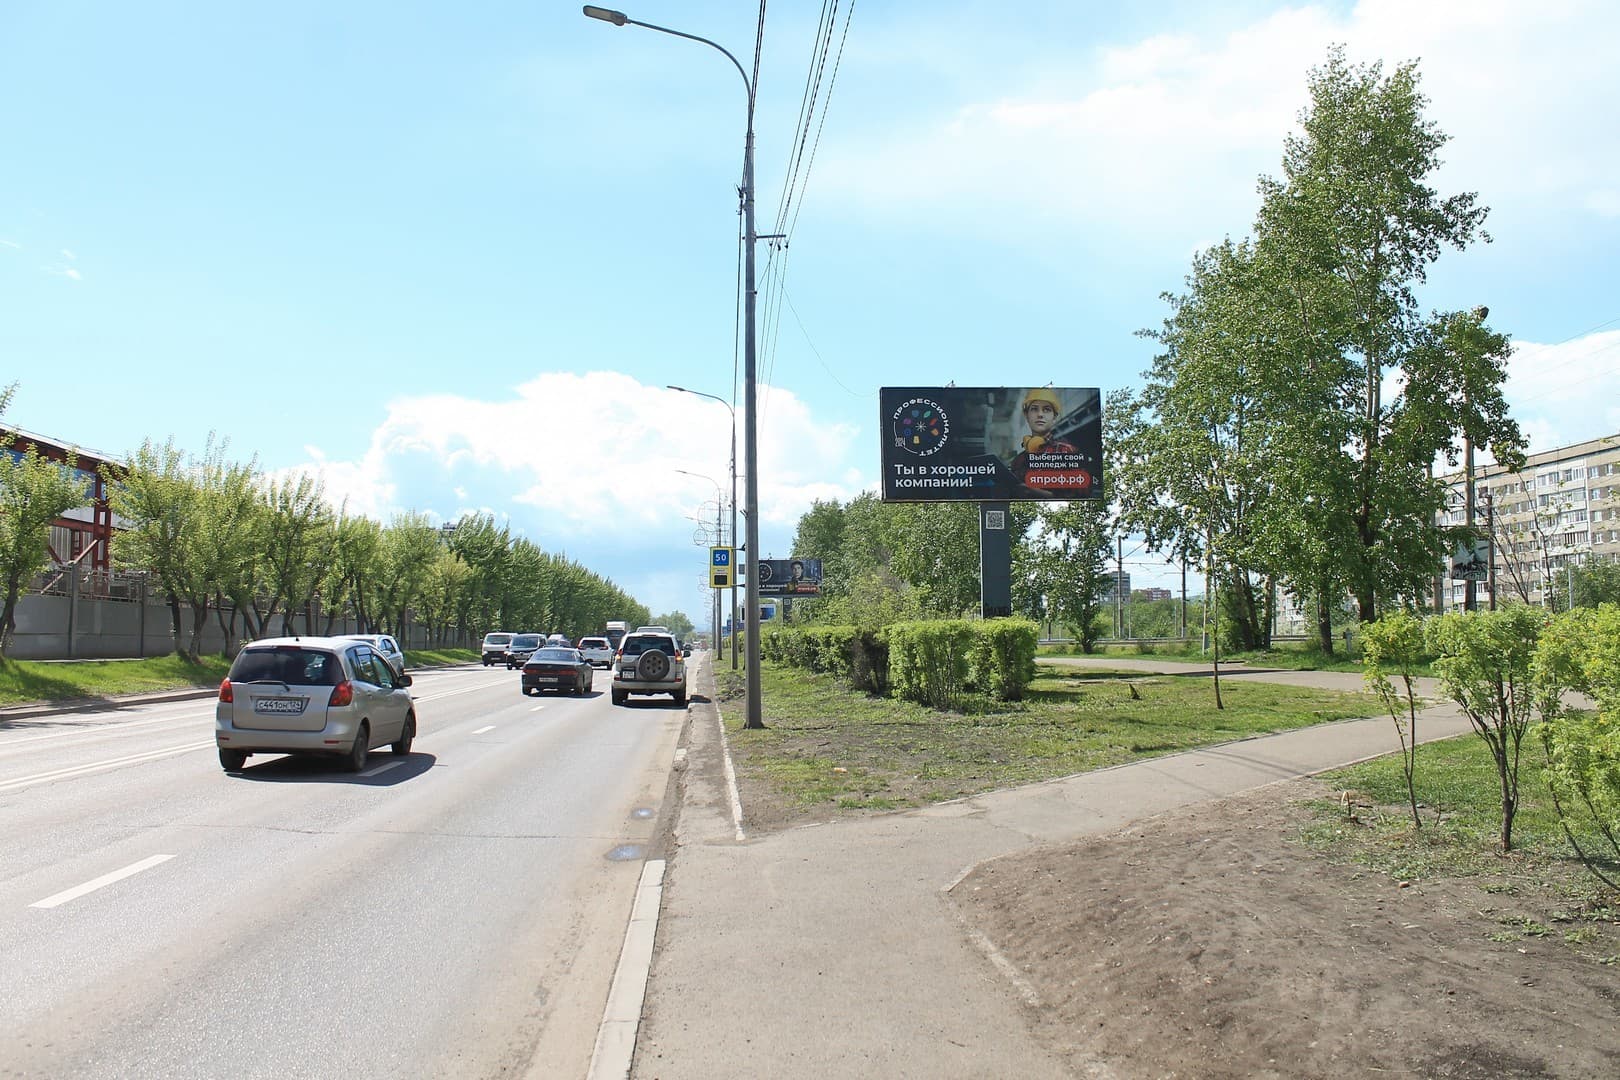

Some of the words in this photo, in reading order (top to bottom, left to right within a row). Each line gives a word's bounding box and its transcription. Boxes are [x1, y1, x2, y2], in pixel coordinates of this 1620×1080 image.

[893, 398, 950, 456] ПРОФЕССИОНАЛИТЕТ
[1029, 453, 1062, 462] Выбери
[1064, 453, 1084, 461] свой
[894, 464, 915, 475] Ты
[919, 465, 927, 475] в
[930, 463, 996, 477] хорошей
[895, 476, 973, 488] компании!
[1030, 474, 1085, 486] япроф.рф
[715, 553, 727, 562] 50
